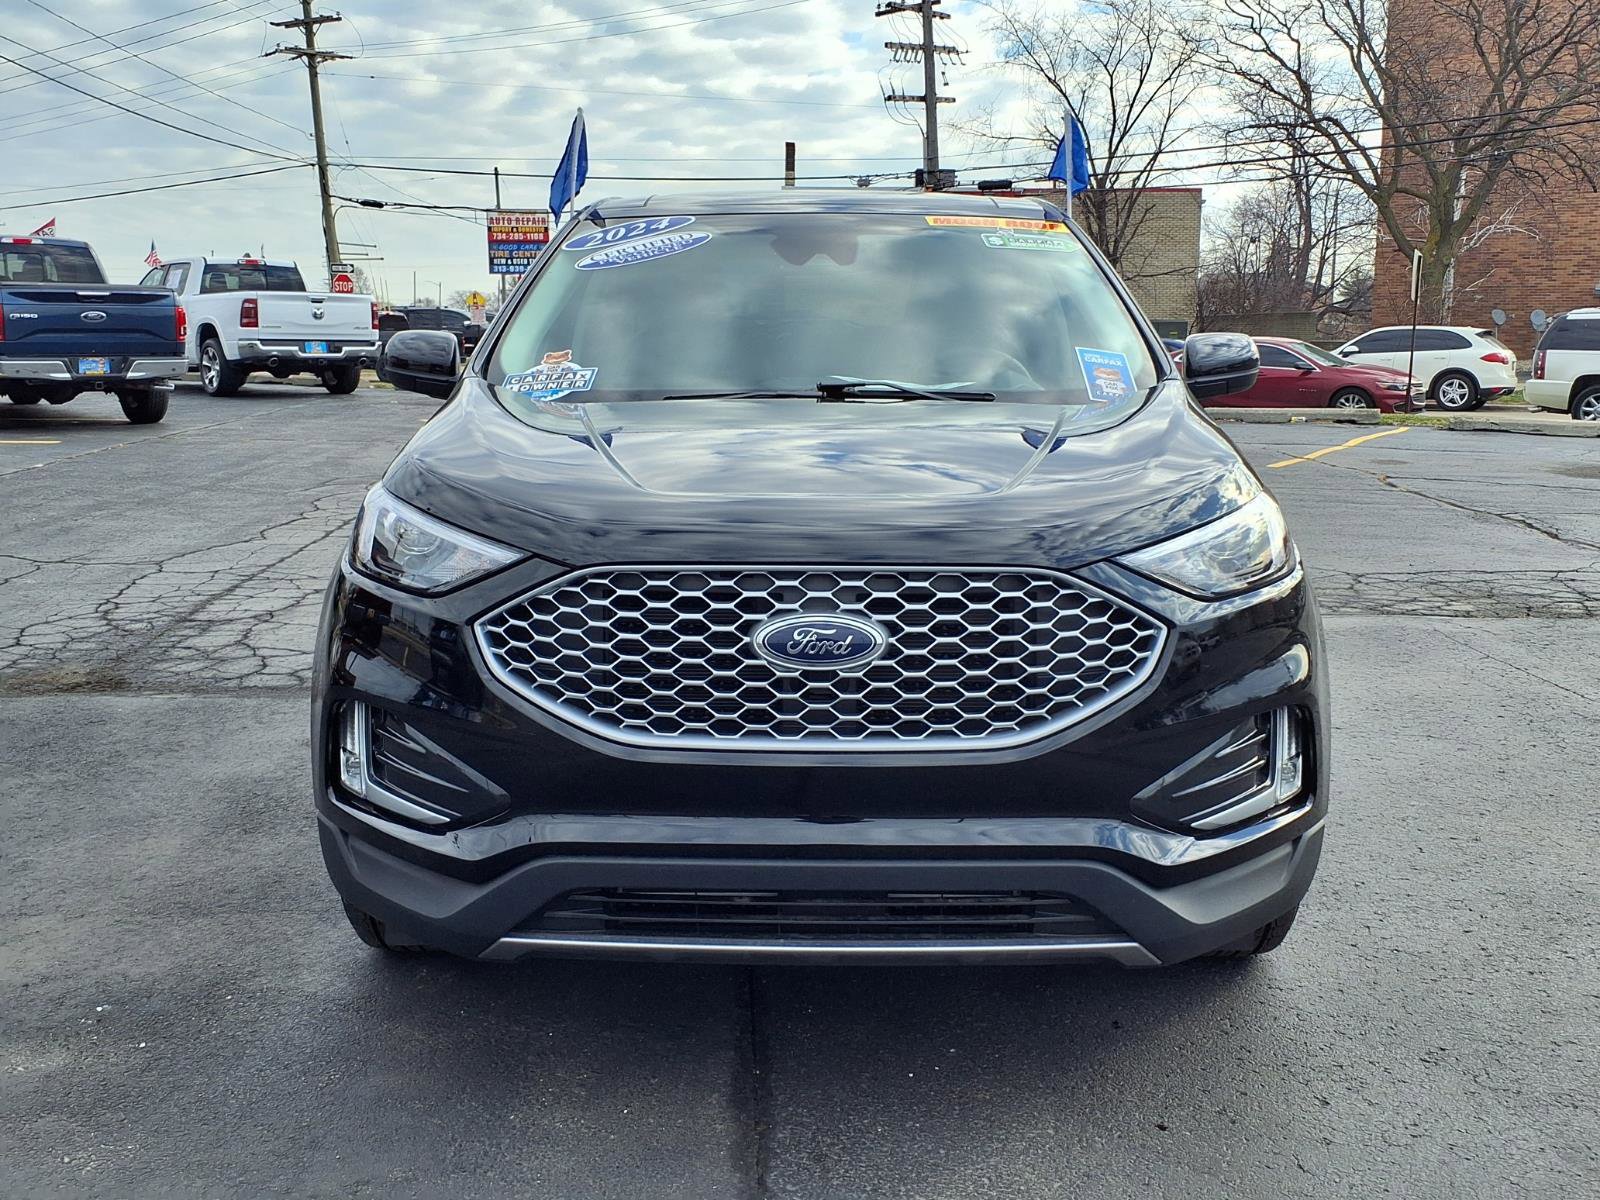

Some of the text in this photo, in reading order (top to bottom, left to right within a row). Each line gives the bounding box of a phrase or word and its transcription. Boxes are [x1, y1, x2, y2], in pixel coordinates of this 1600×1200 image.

[490, 217, 546, 226] AUTO REPAIR
[933, 217, 997, 227] MOON
[583, 217, 670, 248] 2024
[590, 233, 693, 261] CERTIFIED
[490, 250, 510, 258] TIRE
[618, 245, 684, 264] VEHICLE
[334, 281, 353, 292] STOP
[511, 372, 588, 384] CARFAX
[520, 380, 585, 392] OWNER
[786, 627, 854, 655] Ford
